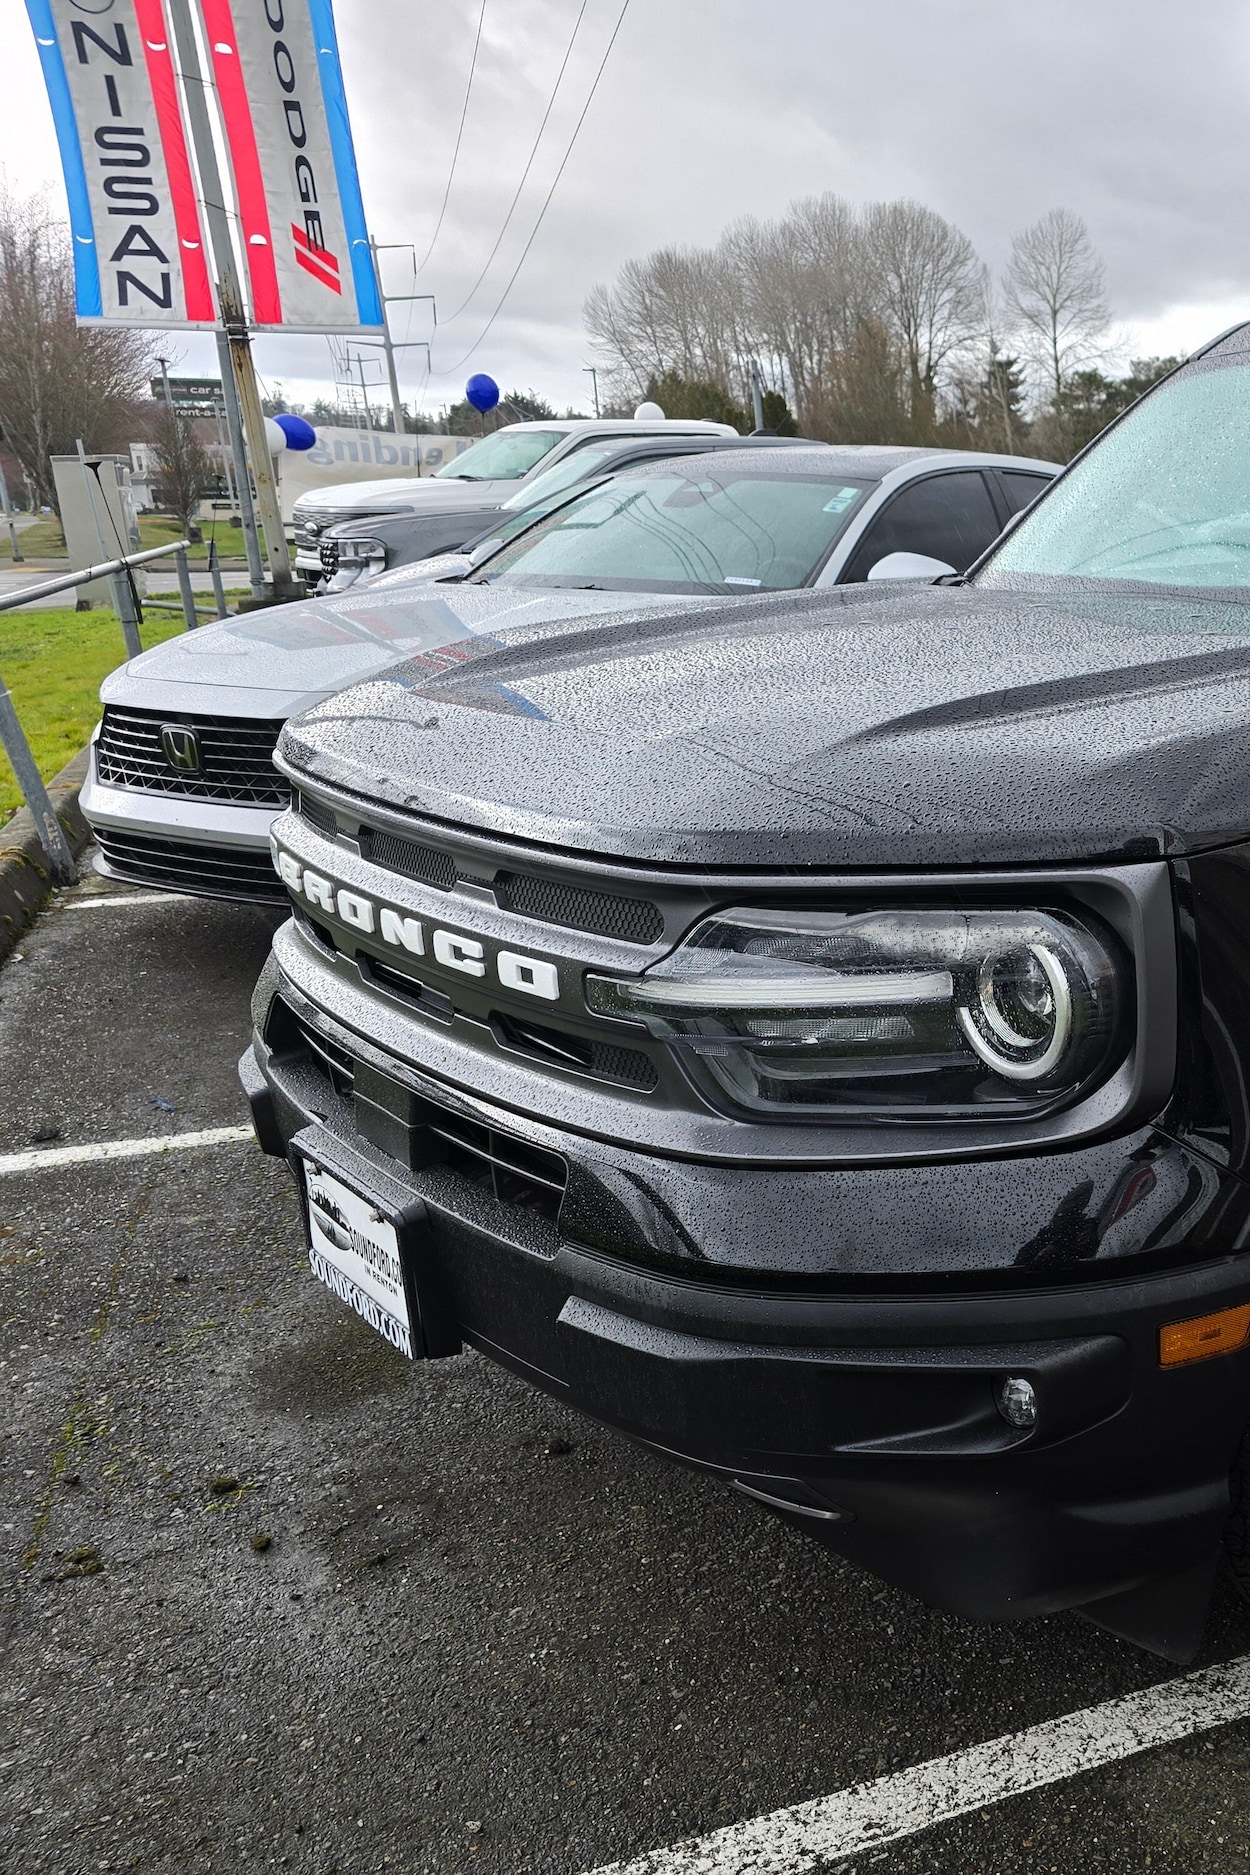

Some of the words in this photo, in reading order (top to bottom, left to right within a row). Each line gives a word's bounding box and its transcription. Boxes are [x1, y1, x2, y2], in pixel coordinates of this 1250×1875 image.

[71, 20, 173, 309] NISSAN
[279, 851, 560, 1001] BRONCO
[308, 1249, 413, 1361] SOUNDFORD.COM
[372, 1270, 398, 1297] RENTON
